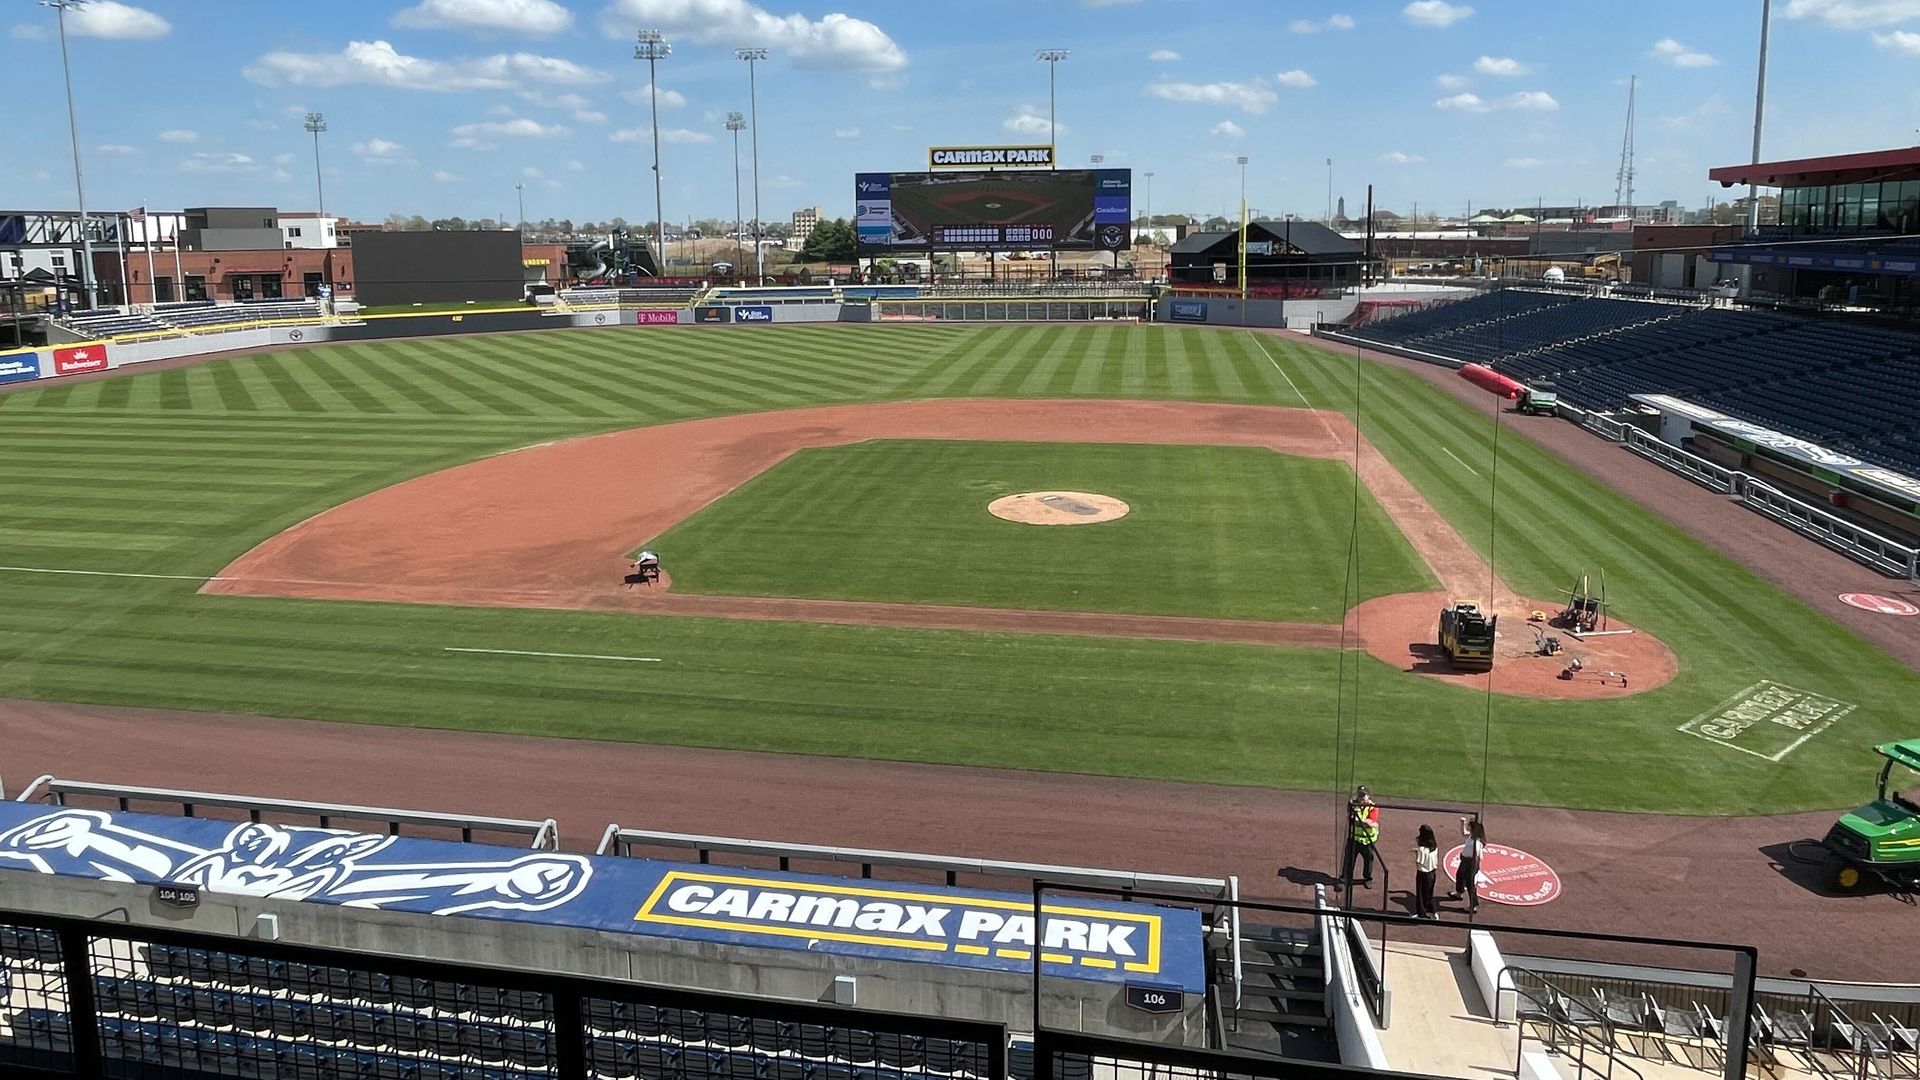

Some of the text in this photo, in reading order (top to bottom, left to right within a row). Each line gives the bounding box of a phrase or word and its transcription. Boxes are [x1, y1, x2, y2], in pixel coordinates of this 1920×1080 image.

[1007, 149, 1050, 162] PARK
[648, 313, 676, 322] Mobile
[61, 359, 102, 370] Budweiser
[160, 890, 196, 902] 104 105
[1489, 881, 1553, 901] DECK BUILDER
[958, 909, 1137, 957] PARK
[1143, 993, 1166, 1005] 106
